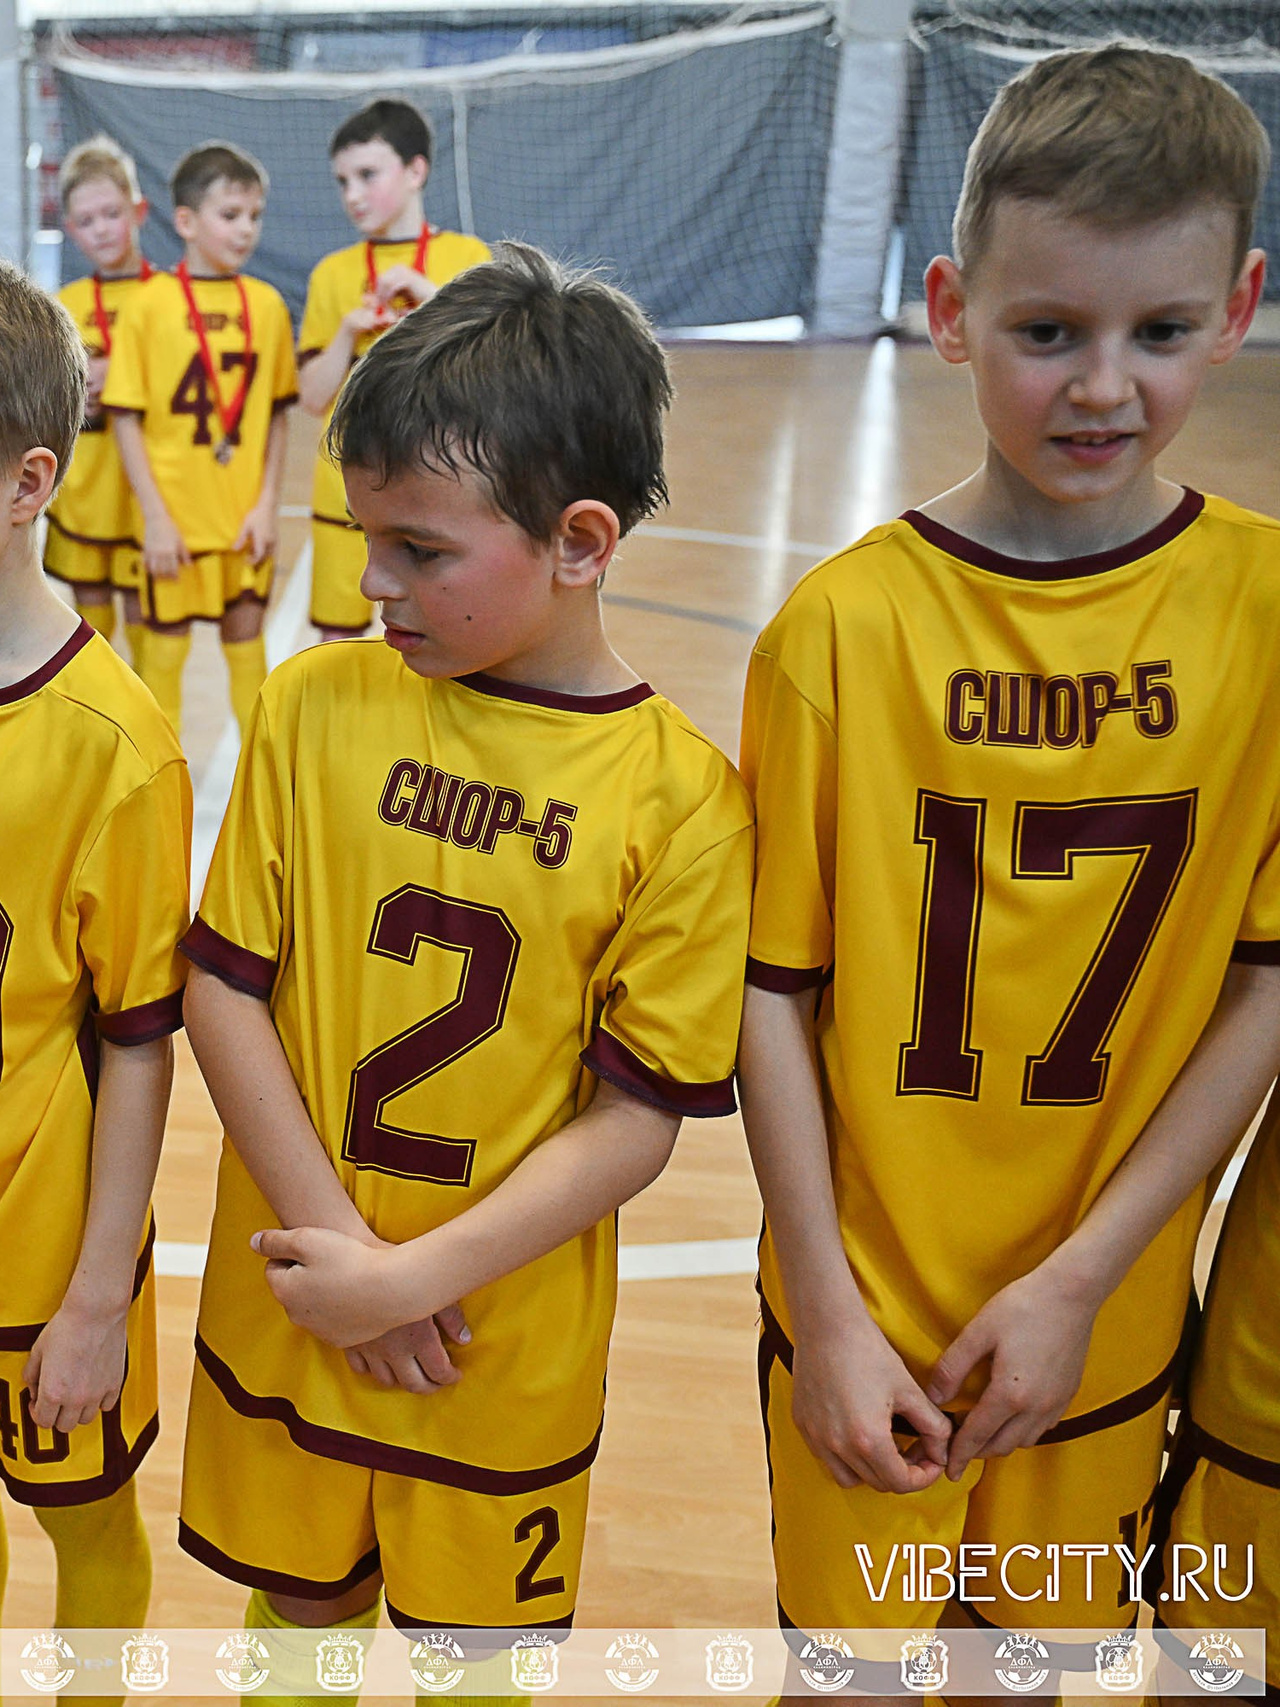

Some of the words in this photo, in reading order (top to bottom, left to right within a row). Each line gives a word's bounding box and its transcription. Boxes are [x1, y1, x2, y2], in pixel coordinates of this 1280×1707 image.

[171, 351, 258, 446] 47
[945, 659, 1178, 750] СШОР-5
[377, 757, 579, 870] СШОР-5
[895, 786, 1200, 1107] 17
[340, 882, 523, 1188] 2
[513, 1505, 566, 1605] 2
